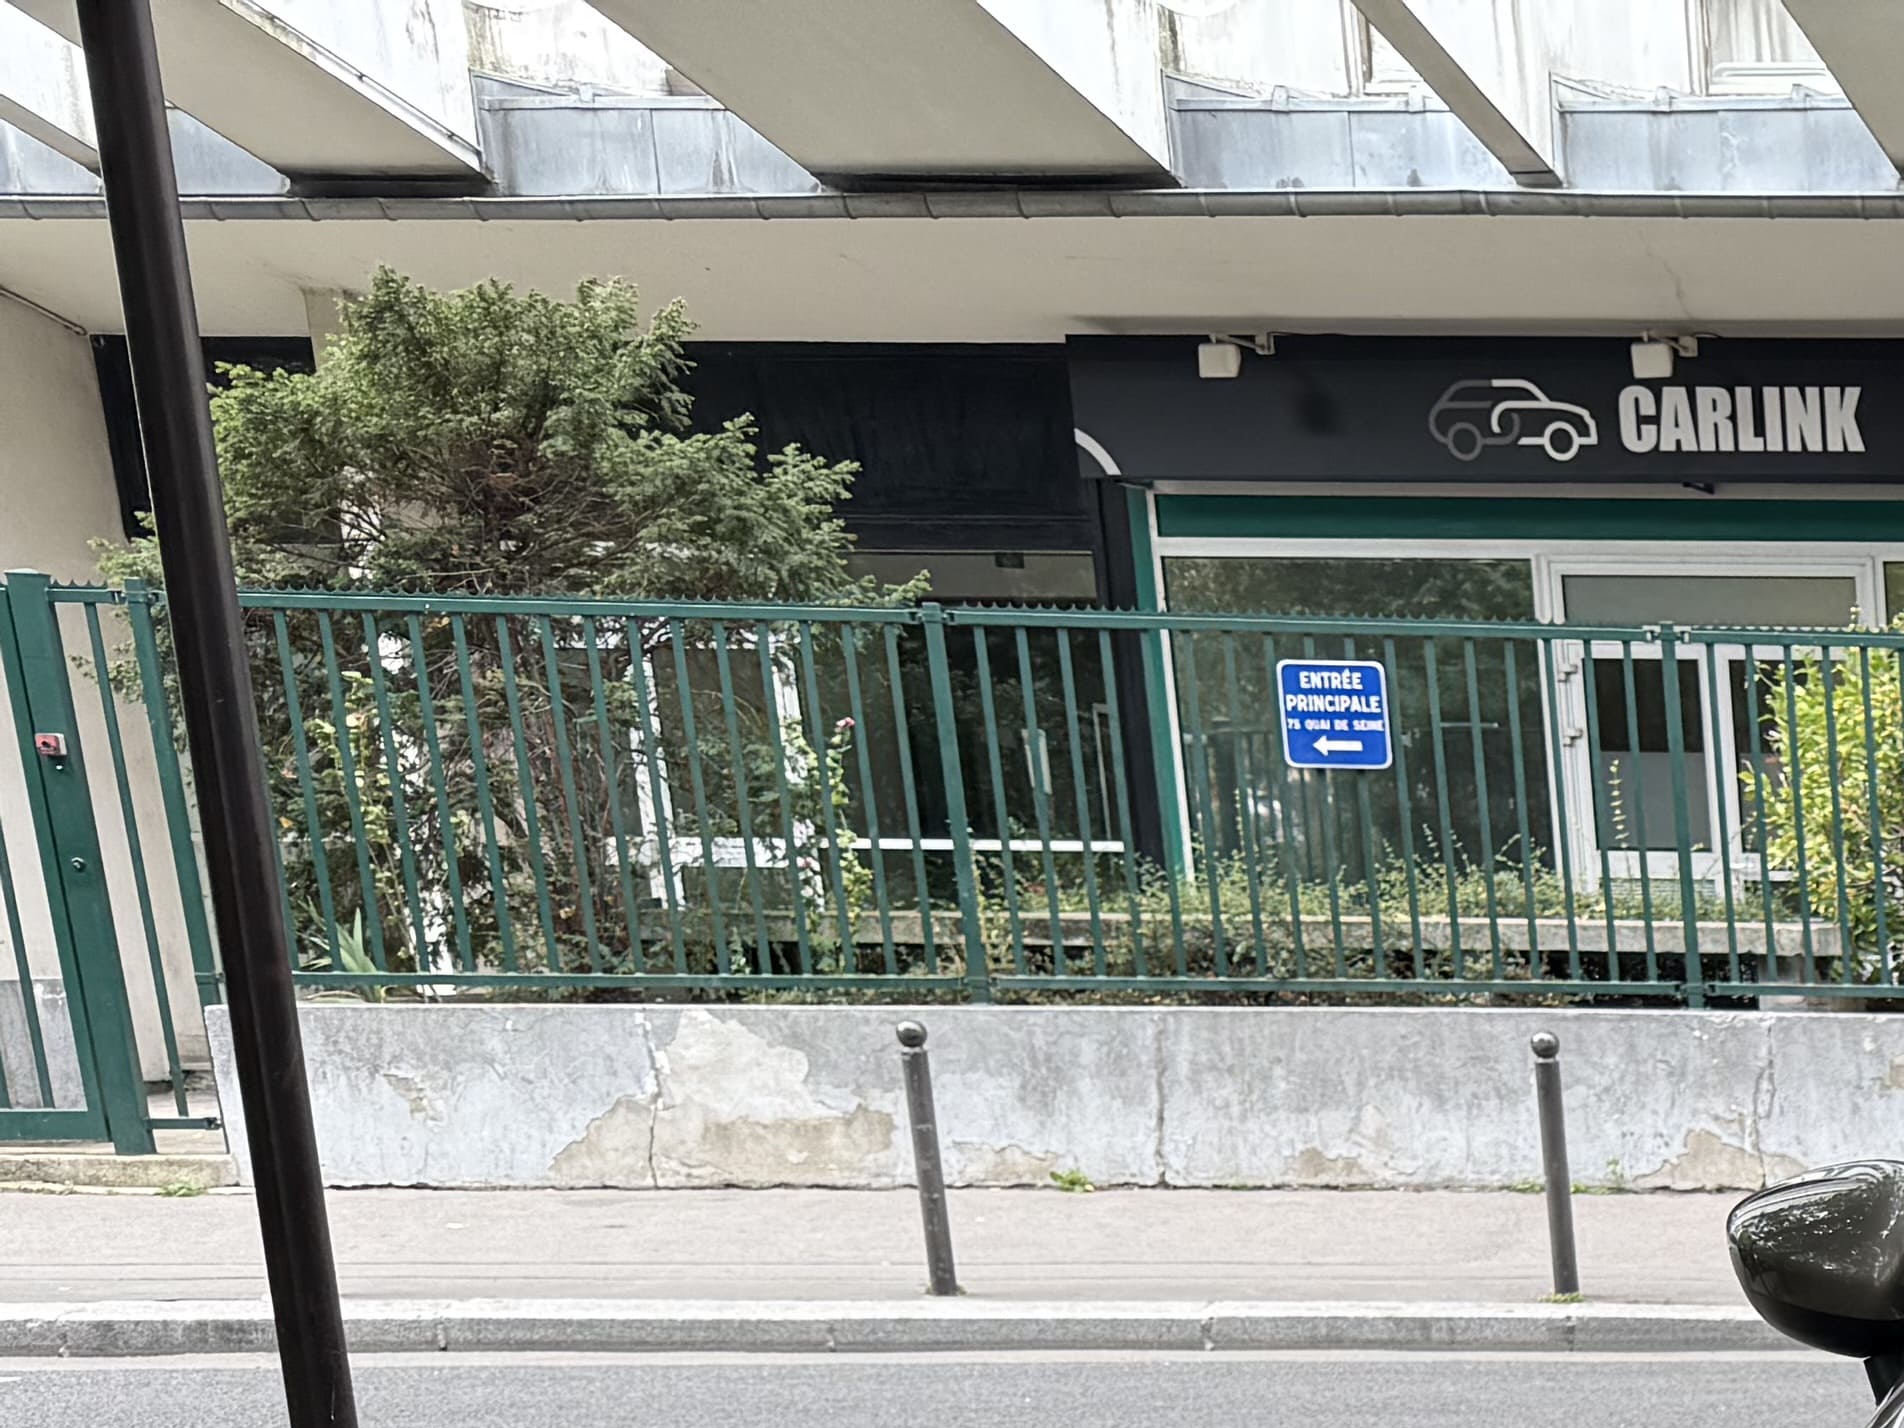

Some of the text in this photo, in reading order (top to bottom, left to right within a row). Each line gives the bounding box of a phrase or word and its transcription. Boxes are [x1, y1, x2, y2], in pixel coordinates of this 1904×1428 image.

[1618, 384, 1866, 453] CARLINK
[1299, 668, 1363, 690] ENTRÉE
[1285, 694, 1381, 713] PRINCIPALE
